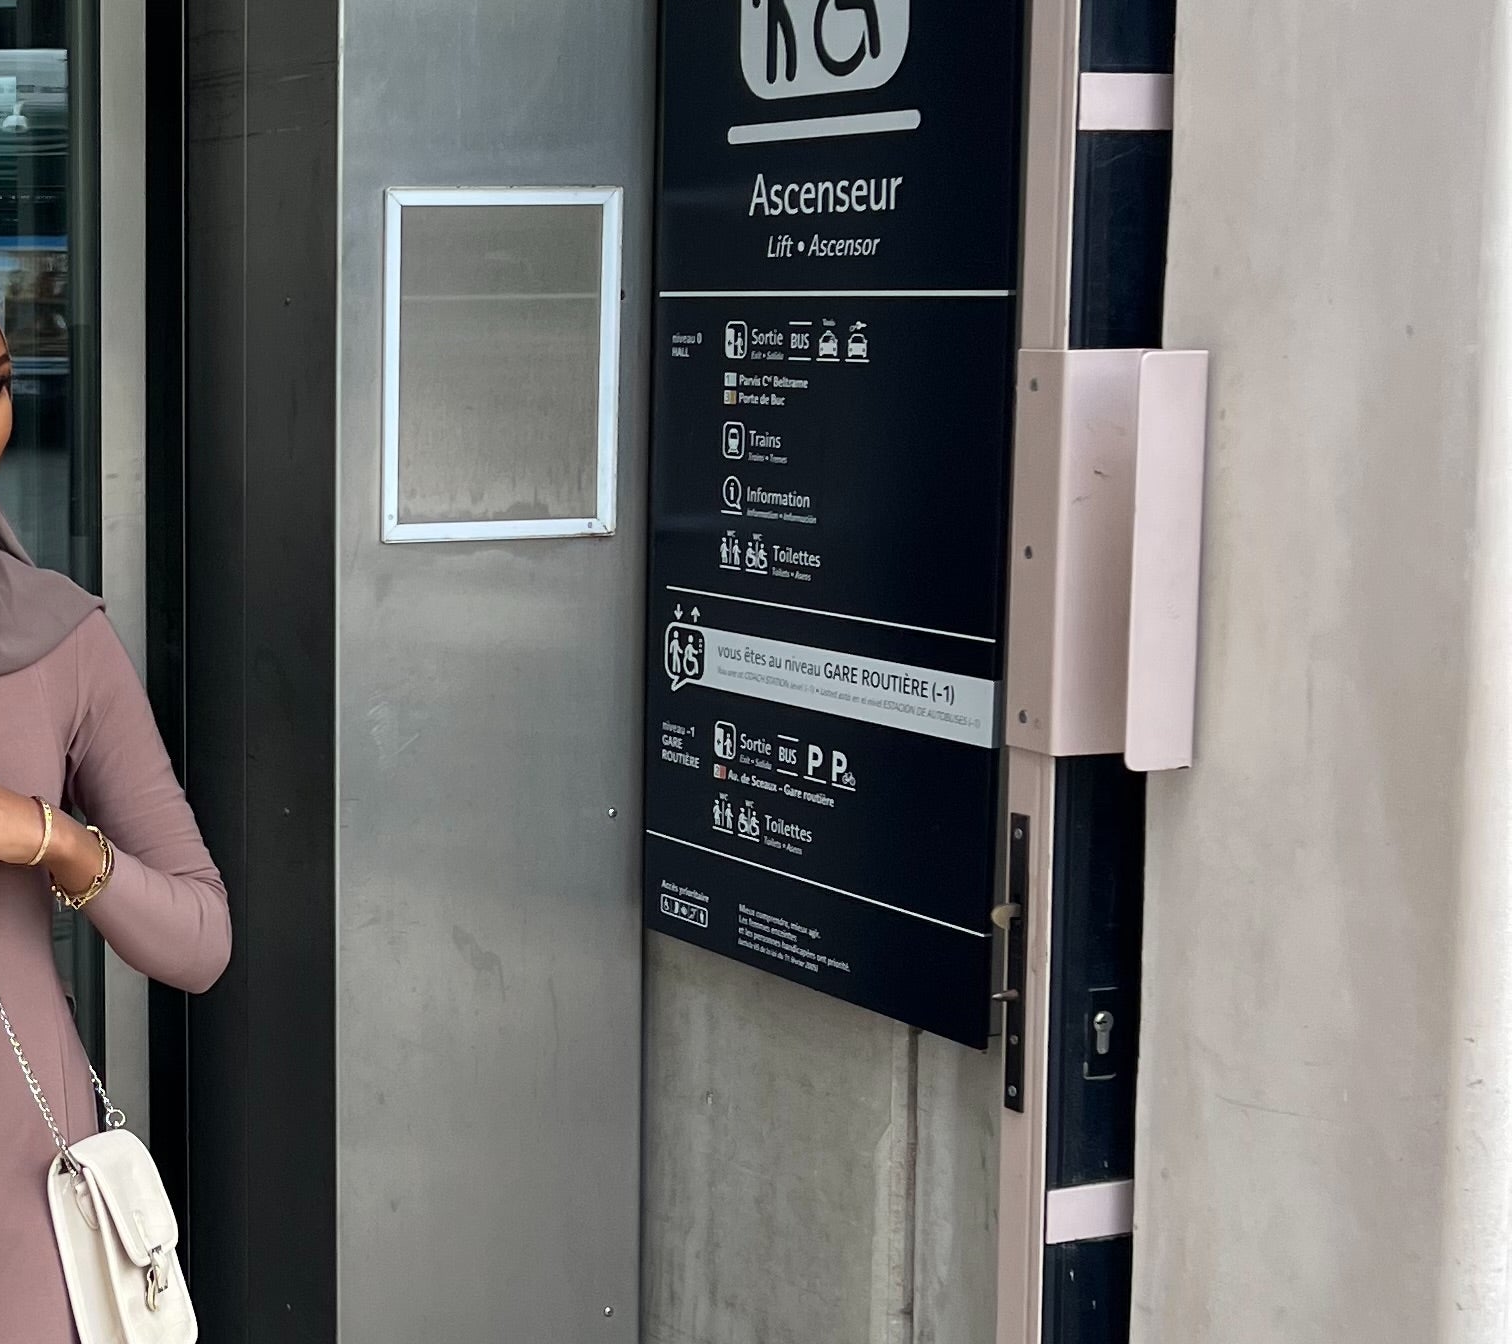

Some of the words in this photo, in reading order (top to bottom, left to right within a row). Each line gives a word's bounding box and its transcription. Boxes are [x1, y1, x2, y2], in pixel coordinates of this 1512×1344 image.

[748, 173, 903, 216] Ascenseur
[767, 234, 793, 258] Lift
[807, 233, 881, 257] Ascensor
[672, 332, 696, 344] niveau
[696, 332, 703, 344] 0
[751, 328, 784, 345] Sortie
[790, 333, 810, 349] BUS
[671, 346, 690, 357] HALL
[739, 374, 761, 387] Parvis
[773, 375, 808, 388] Beltrame
[738, 392, 759, 404] Porte
[760, 393, 769, 405] de
[771, 393, 786, 406] Buc
[749, 430, 782, 448] Trains
[746, 486, 810, 508] Information
[772, 545, 821, 568] Toilettes
[717, 645, 742, 661] vous
[744, 647, 767, 666] êtes
[768, 654, 782, 668] au
[784, 655, 821, 677] niveau
[823, 662, 858, 684] GARE
[862, 669, 929, 698] ROUTIÈRE
[932, 682, 955, 706] (-1)
[662, 720, 686, 736] niveau
[686, 726, 695, 738] -1
[661, 734, 683, 750] GARE
[661, 749, 700, 769] ROUTIÈRE
[739, 733, 772, 755] Sortie
[778, 746, 797, 765] BUS
[807, 743, 823, 776] P
[832, 750, 848, 782] P
[727, 769, 740, 782] Av.
[740, 773, 750, 785] de
[751, 775, 777, 792] Sceaux
[783, 784, 803, 799] Gare
[803, 792, 835, 807] routière
[764, 815, 813, 842] Toilettes
